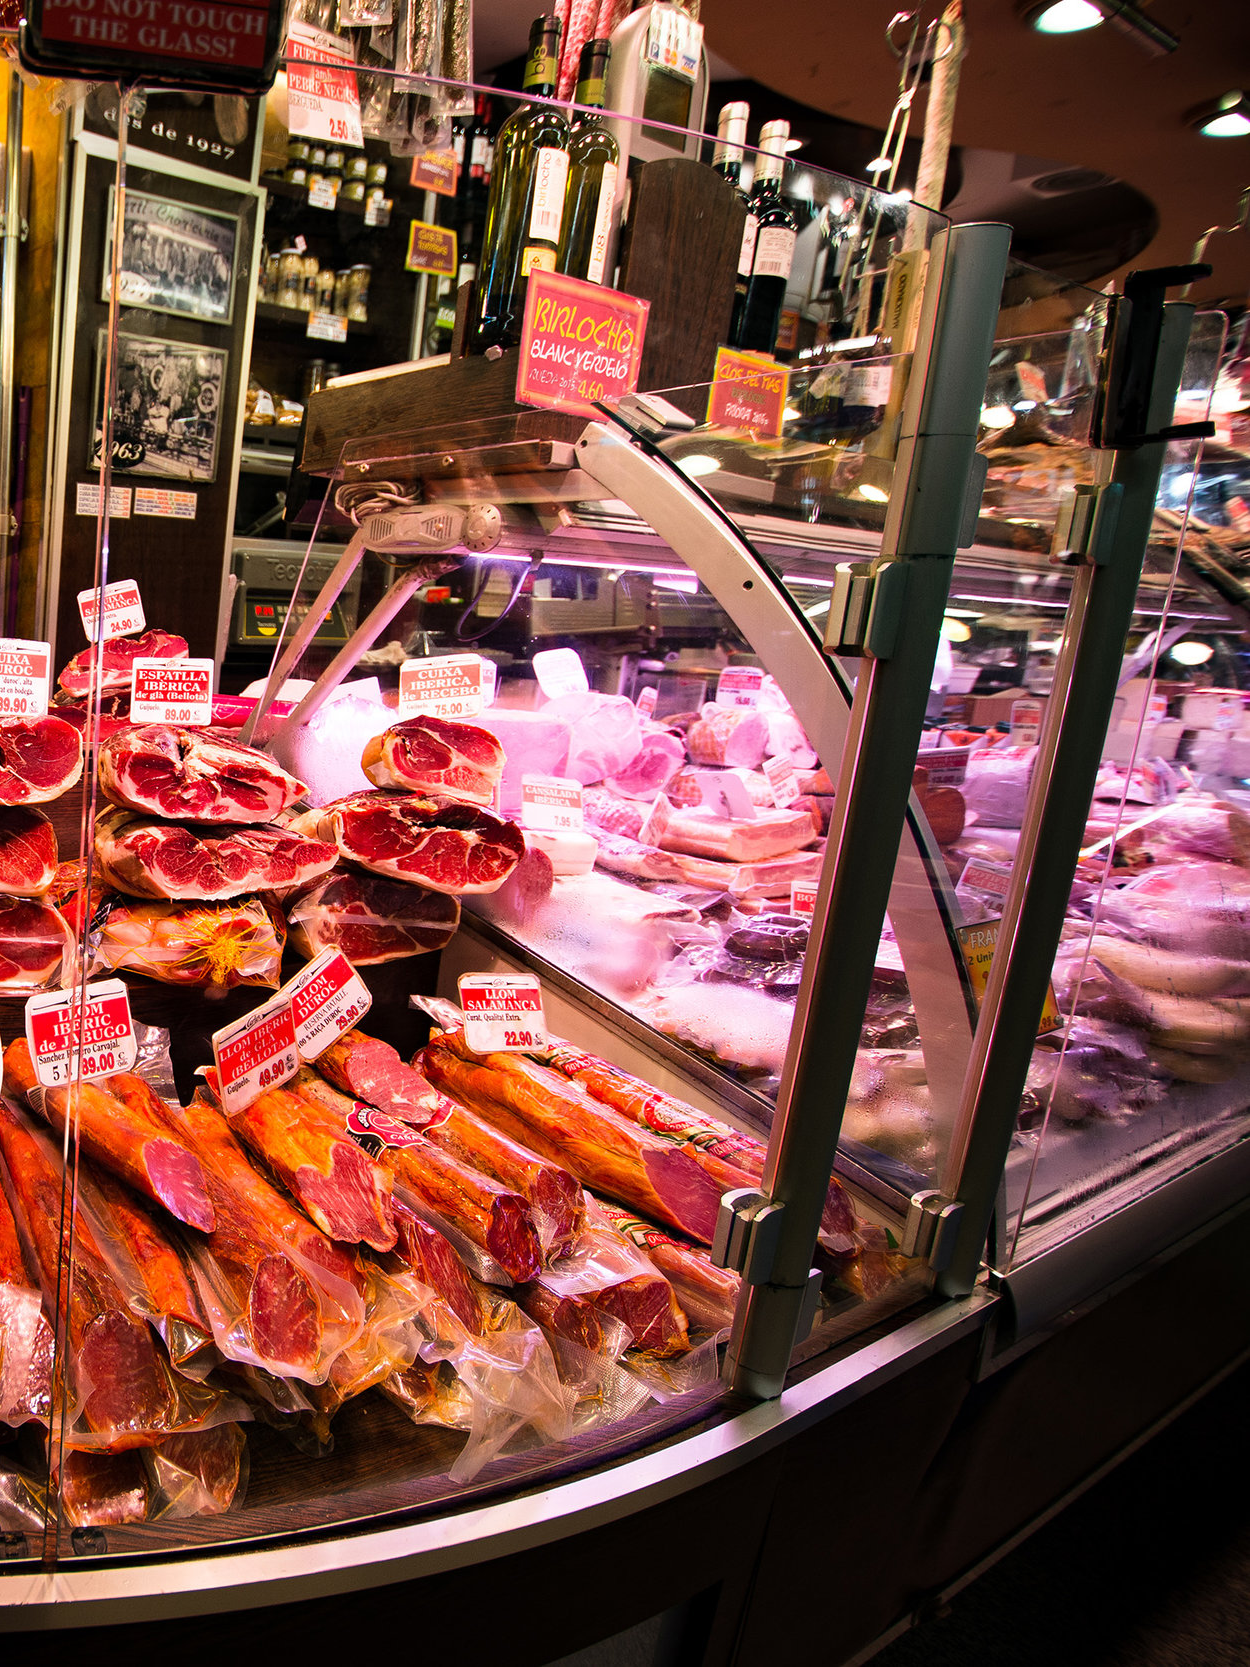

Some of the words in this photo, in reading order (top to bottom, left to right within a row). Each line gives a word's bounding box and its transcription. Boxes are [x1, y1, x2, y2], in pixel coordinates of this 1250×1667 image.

[102, 0, 163, 21] NOT
[169, 4, 266, 36] TOUCH
[70, 16, 129, 44] THE
[138, 23, 237, 59] GLASS!
[289, 73, 322, 96] PEBRE
[329, 118, 348, 141] 2.50
[152, 121, 178, 141] de
[186, 134, 236, 161] 1927
[533, 297, 635, 354] BIRLOCHO
[530, 339, 577, 366] BLANC
[576, 350, 629, 380] VERDEJO
[578, 379, 605, 401] 4.60
[111, 618, 133, 633] 24.90
[138, 669, 208, 682] ESPATLLA
[417, 667, 464, 680] CUIXA
[136, 691, 148, 700] de
[149, 691, 164, 702] glà
[167, 691, 209, 702] (Bellota)
[401, 691, 417, 701] de
[420, 686, 481, 701] RECEBO
[164, 708, 191, 722] 89.00
[434, 702, 463, 716] 75.00
[525, 785, 579, 800] CANSALADA
[554, 815, 572, 828] 7.95
[967, 956, 975, 966] 2
[295, 974, 329, 1007] LLOM
[298, 979, 338, 1019] DUROC
[485, 989, 517, 1000] LLOM
[58, 1002, 104, 1024] LLOM
[467, 1000, 538, 1011] SALAMANCA
[335, 1004, 360, 1032] 29.90
[39, 1039, 57, 1053] de
[61, 1023, 128, 1049] JABUGO
[504, 1030, 533, 1047] 22.90
[38, 1051, 68, 1065] Sanchez
[67, 1046, 91, 1060] Romro
[219, 1036, 251, 1063] LLOM
[231, 1036, 290, 1081] (BELLOTA)
[239, 1050, 251, 1062] de
[52, 1065, 60, 1081] 5
[258, 1058, 285, 1088] 49.90
